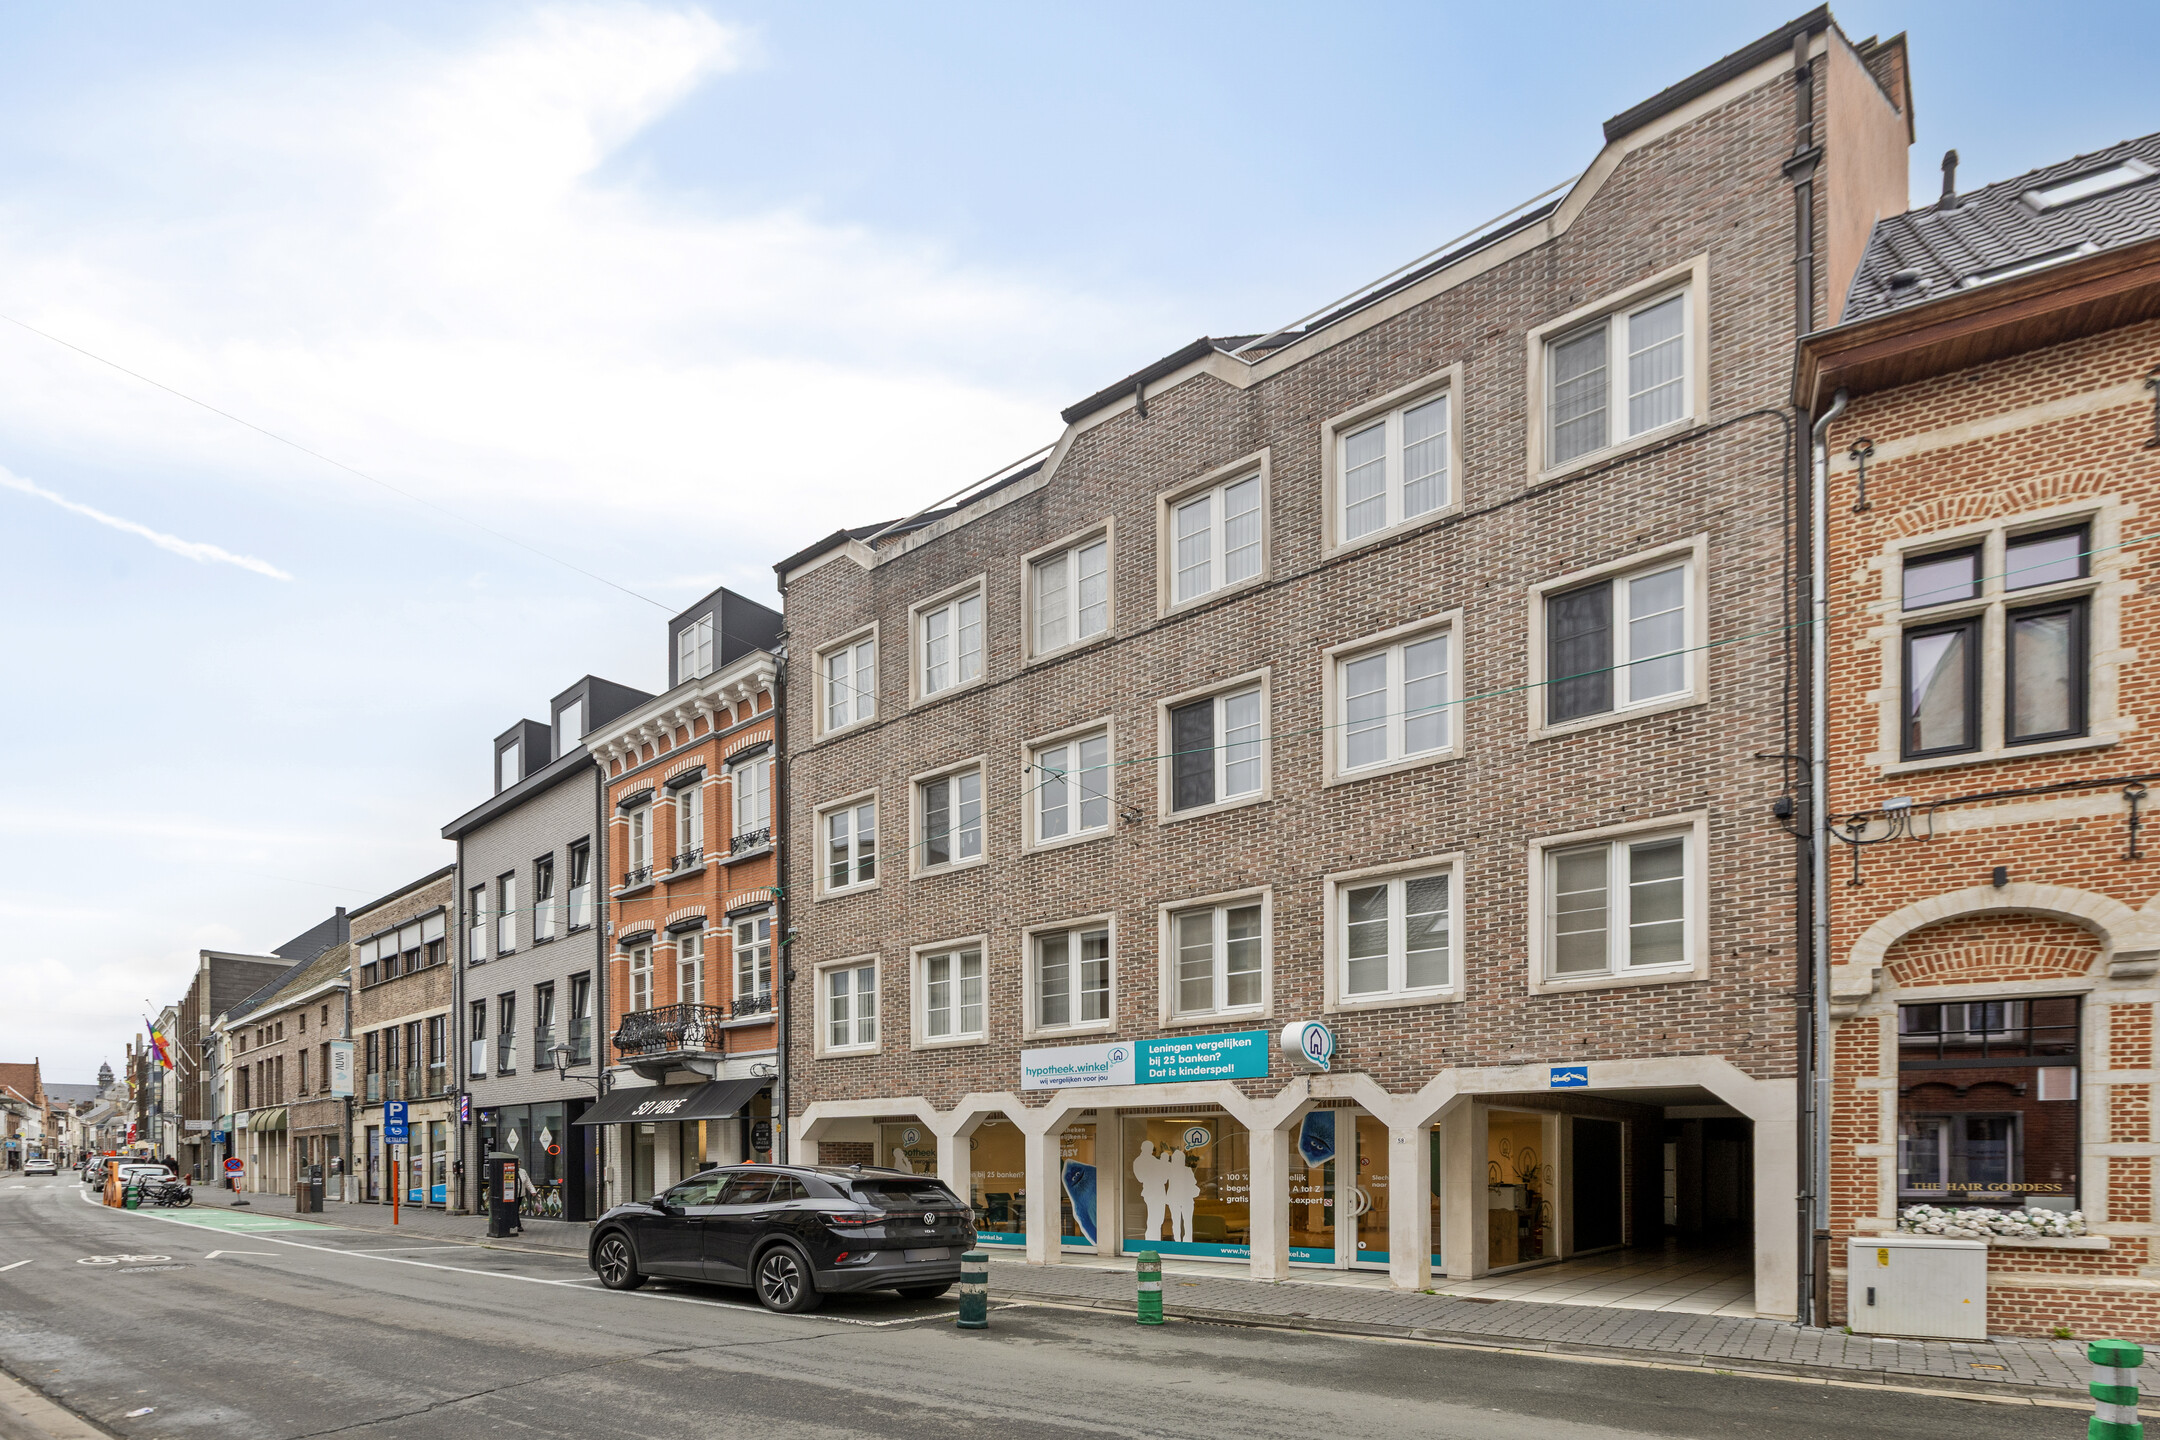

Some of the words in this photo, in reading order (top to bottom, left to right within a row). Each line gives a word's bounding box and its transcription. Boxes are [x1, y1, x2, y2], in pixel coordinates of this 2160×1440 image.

[1149, 1043, 1192, 1053] Leningen
[1195, 1038, 1252, 1050] vergelijken
[1149, 1057, 1160, 1067] bij
[1163, 1055, 1175, 1065] 25
[1178, 1052, 1221, 1064] banken?
[1026, 1061, 1109, 1077] hypotheek.winkel
[1149, 1068, 1166, 1077] Dat
[1168, 1067, 1176, 1076] is
[1179, 1064, 1235, 1075] kinderspel!
[1050, 1077, 1082, 1085] vergelijken
[1098, 1075, 1108, 1083] jou
[389, 1102, 403, 1116] P
[631, 1101, 656, 1115] SO
[647, 1099, 688, 1115] PURE
[997, 1170, 1024, 1178] banken?
[1912, 1182, 1941, 1191] THE
[1946, 1182, 1983, 1191] HAIR
[1988, 1182, 2063, 1192] GODDESS
[1226, 1195, 1249, 1204] gratis
